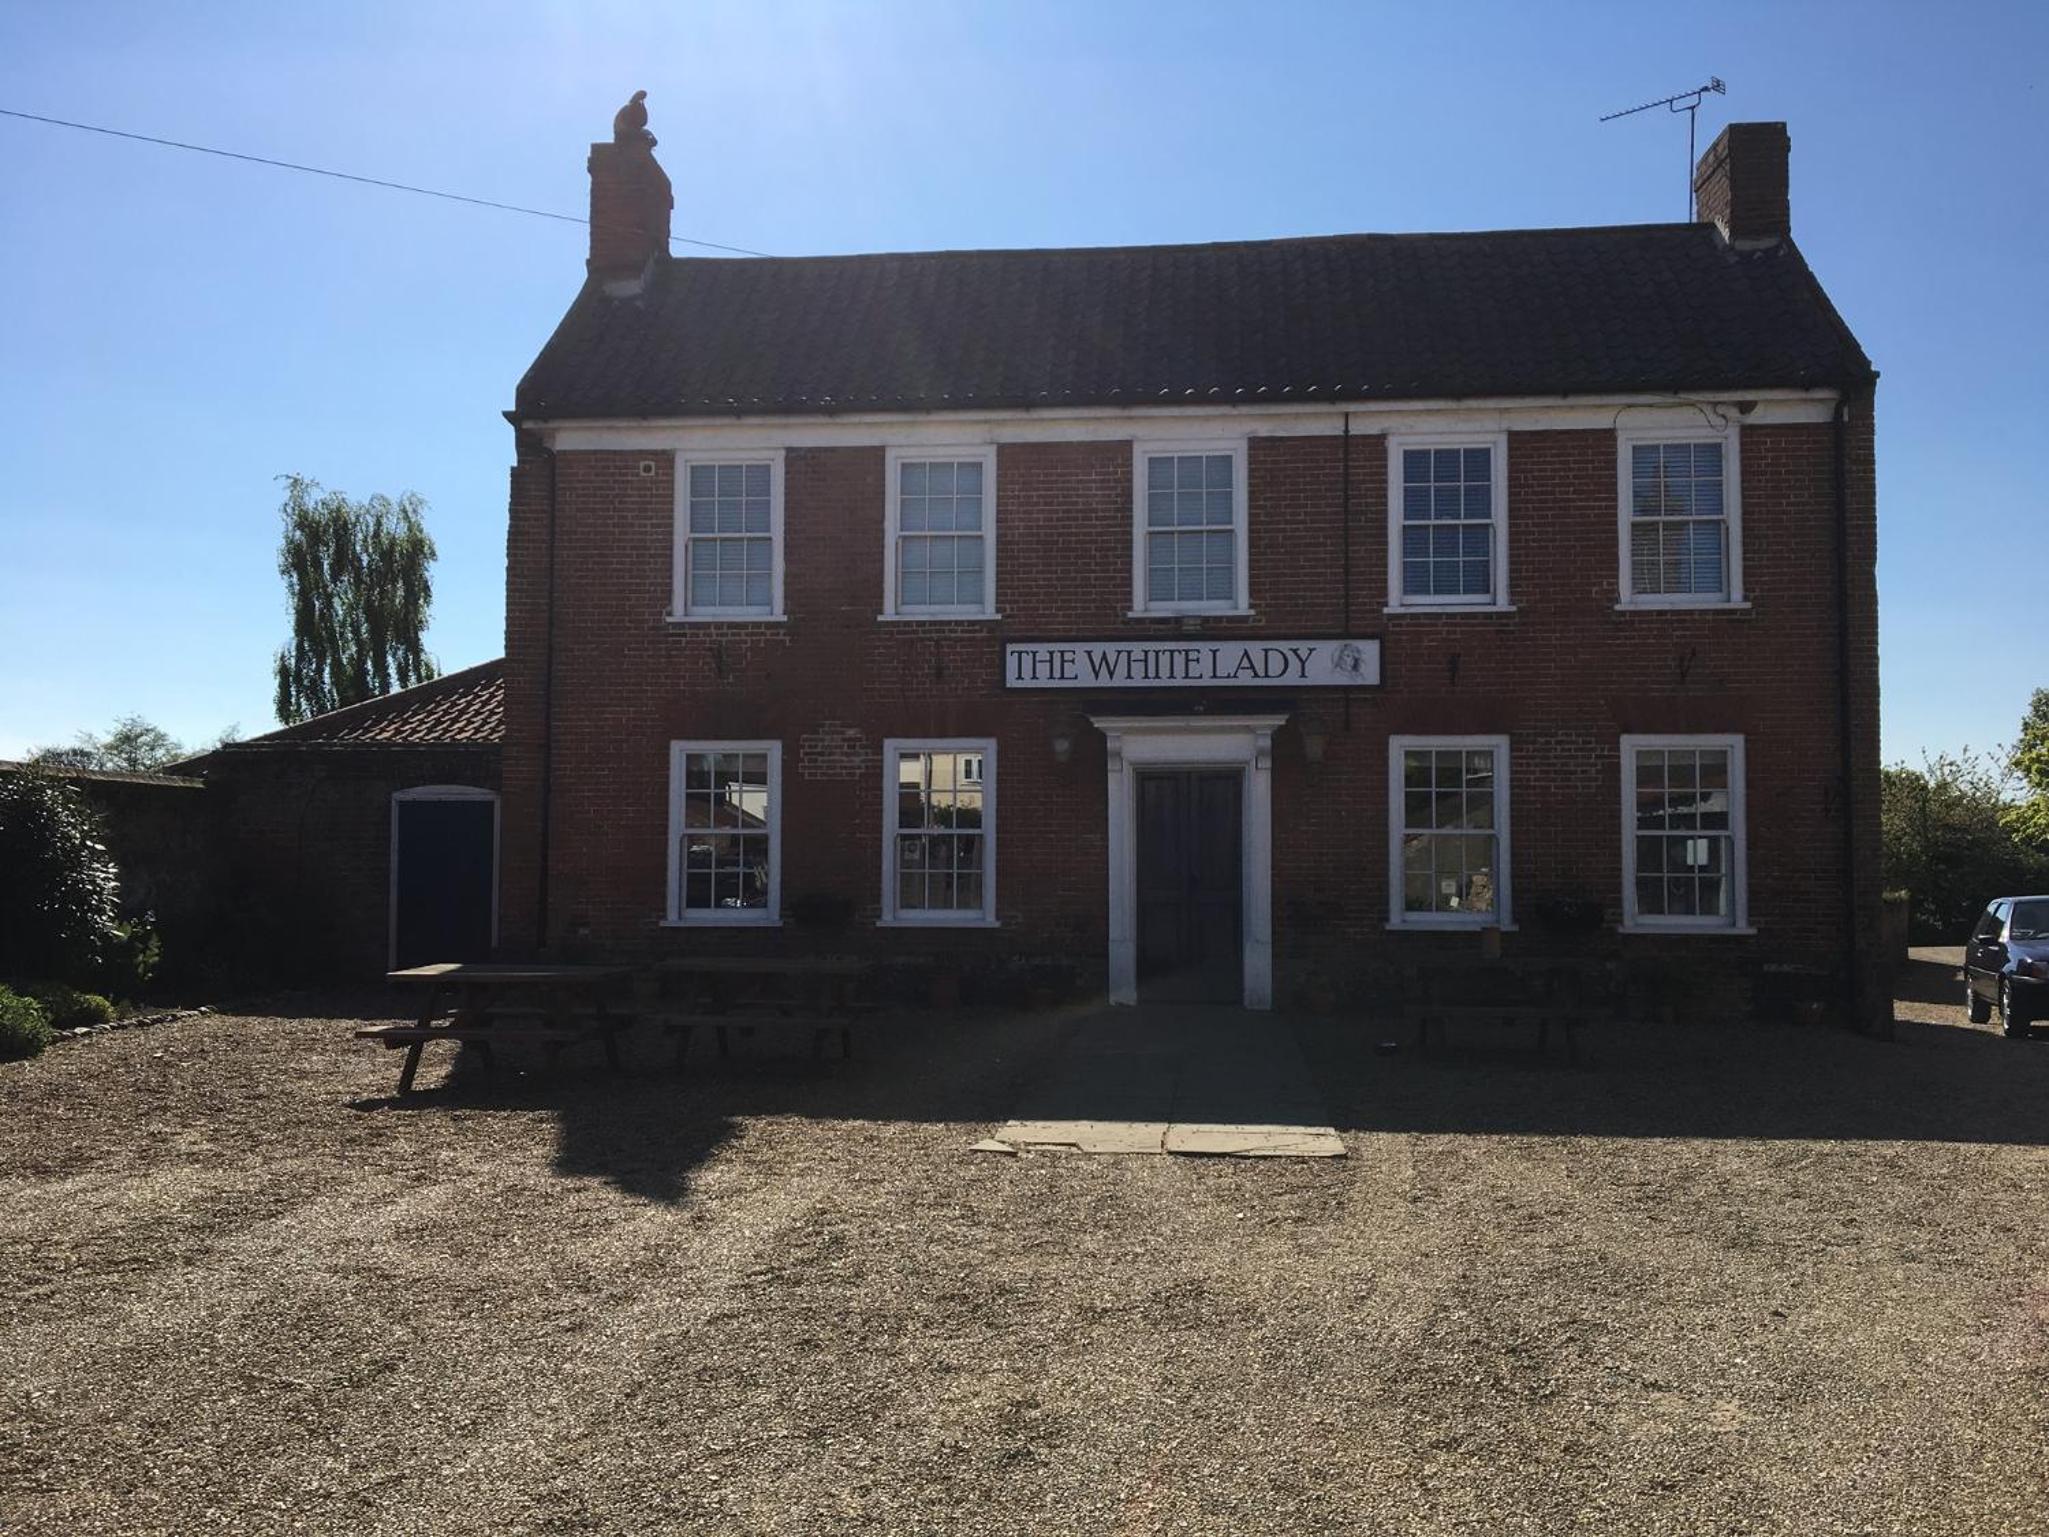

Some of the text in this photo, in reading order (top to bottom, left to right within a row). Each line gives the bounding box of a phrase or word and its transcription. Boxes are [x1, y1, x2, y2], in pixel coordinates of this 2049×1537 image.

[1010, 647, 1317, 681] THE WHITE LADY
